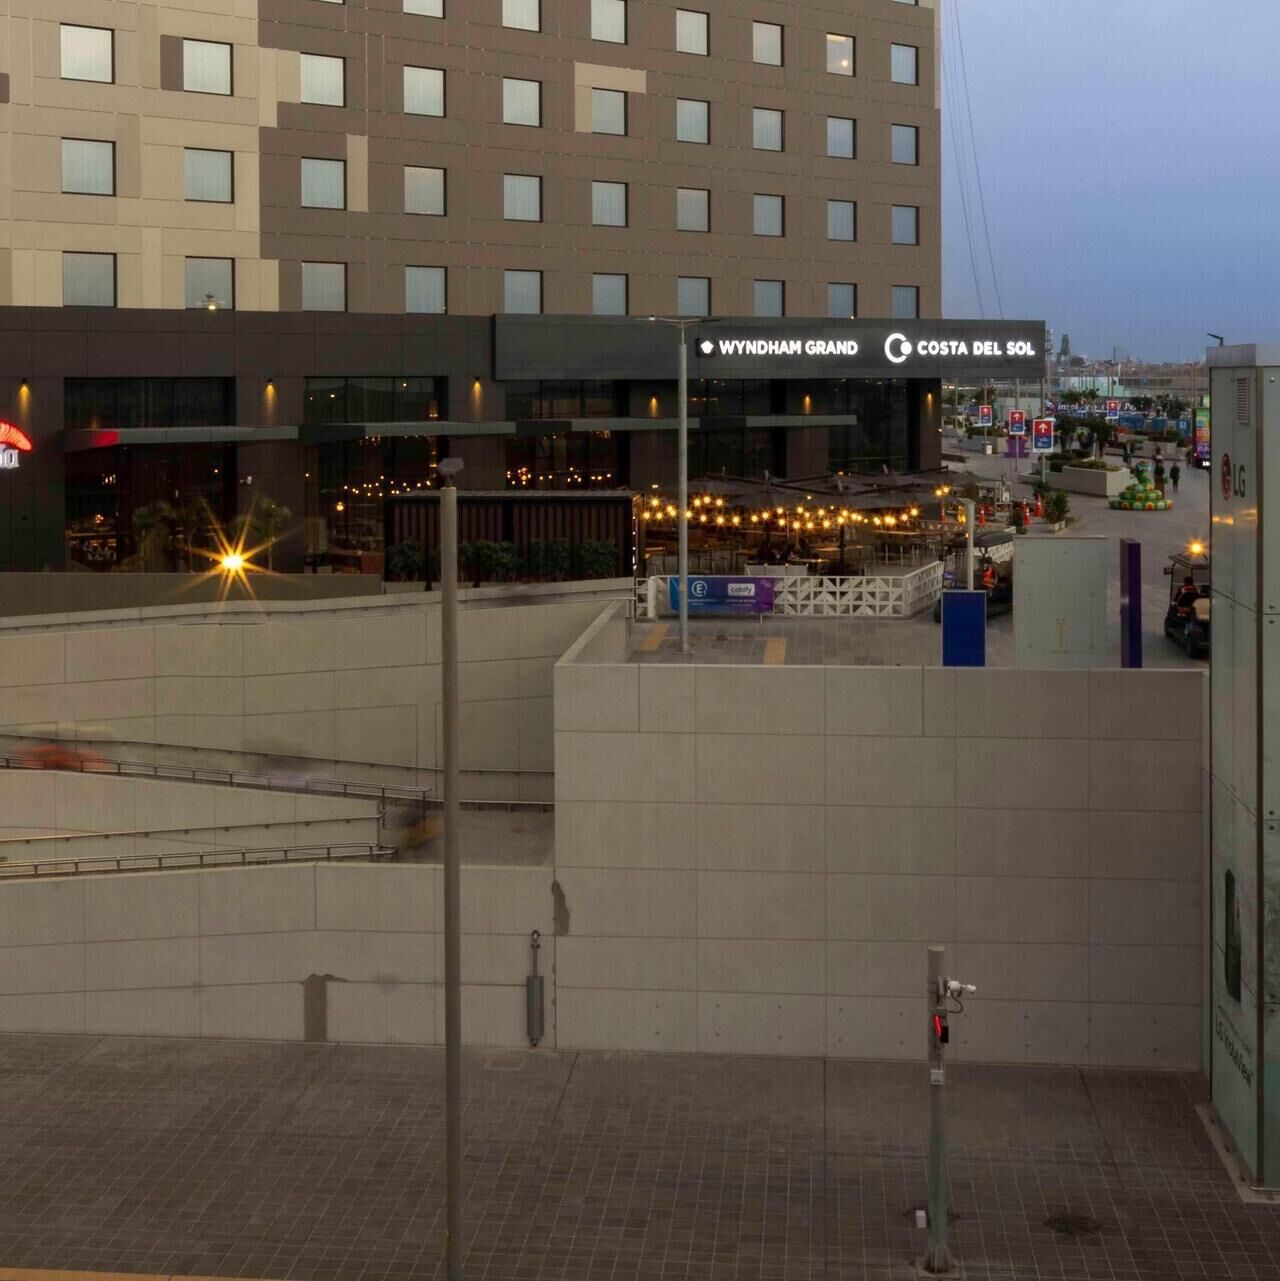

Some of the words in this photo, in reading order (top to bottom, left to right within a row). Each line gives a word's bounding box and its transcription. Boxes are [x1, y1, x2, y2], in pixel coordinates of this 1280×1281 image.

[719, 340, 802, 356] WYNDHAM
[805, 340, 859, 356] GRAND
[917, 341, 969, 356] COSTA
[972, 341, 1003, 356] DEL
[1006, 341, 1036, 356] SOL
[1233, 463, 1246, 498] LG
